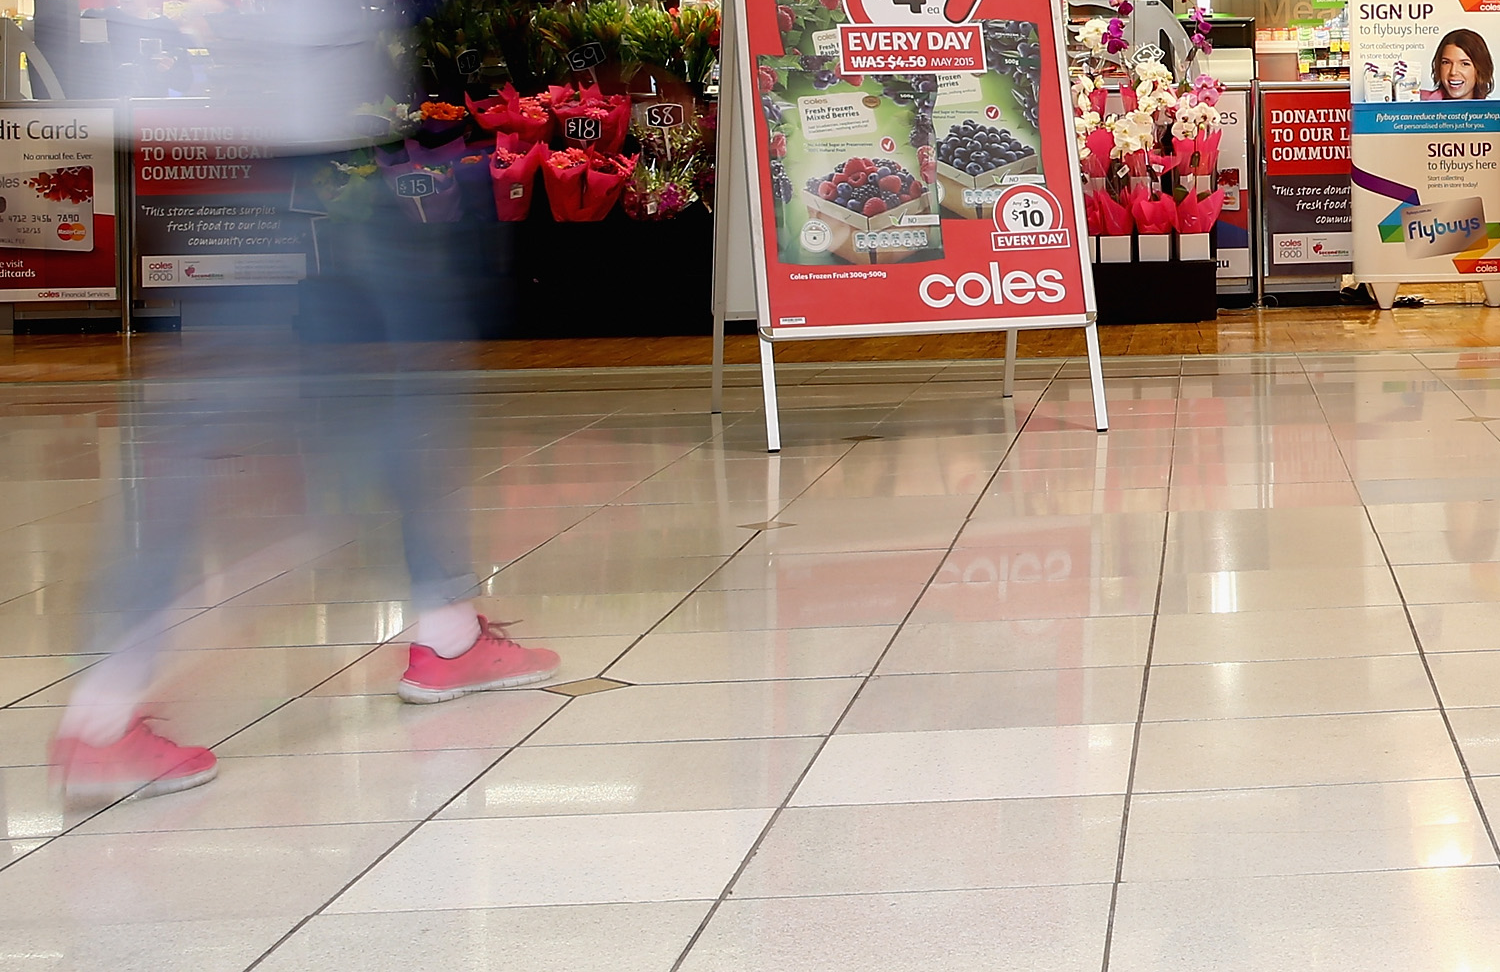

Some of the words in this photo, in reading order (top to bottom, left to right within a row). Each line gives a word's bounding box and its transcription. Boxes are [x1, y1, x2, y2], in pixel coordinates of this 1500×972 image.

[927, 5, 940, 14] ea
[1360, 3, 1402, 20] SIGN
[1408, 3, 1434, 20] UP
[1360, 25, 1371, 35] to
[1373, 23, 1412, 37] flybuys
[1415, 23, 1440, 35] here
[848, 31, 921, 52] EVERY
[928, 31, 973, 50] DAY
[1359, 42, 1374, 50] Start
[1375, 42, 1404, 51] collecting
[1405, 42, 1425, 51] points
[851, 56, 886, 68] WAS
[888, 55, 927, 69] $4.50
[930, 56, 952, 67] MAY
[954, 56, 975, 66] 2015
[1004, 58, 1020, 66] 500g
[1383, 52, 1403, 61] today!
[803, 96, 828, 106] coles
[651, 107, 674, 125] $8
[805, 107, 826, 116] Fresh
[828, 104, 854, 114] Frozen
[806, 113, 831, 122] Mixed
[832, 110, 860, 119] Berries
[1376, 112, 1400, 122] flybuys
[1400, 113, 1412, 121] can
[1413, 113, 1435, 121] reduce
[1468, 114, 1484, 122] your
[1484, 113, 1500, 121] shop.
[26, 119, 89, 140] Cards
[568, 117, 596, 139] $18
[141, 127, 234, 142] DONATING
[1271, 129, 1294, 143] TO
[1300, 127, 1334, 142] OUR
[141, 147, 165, 162] TO
[171, 146, 208, 161] OUR
[215, 145, 275, 160] LOCAL
[1427, 142, 1465, 158] SIGN
[1470, 142, 1492, 157] UP
[23, 153, 34, 161] No
[36, 152, 64, 161] annual
[65, 152, 75, 161] fee.
[76, 153, 93, 161] Ever.
[1428, 162, 1437, 170] to
[1440, 160, 1474, 172] flybuys
[1476, 159, 1497, 169] here
[141, 164, 252, 181] COMMUNITY
[1441, 175, 1465, 183] collecting
[1296, 186, 1321, 196] store
[1023, 198, 1031, 208] 3
[1296, 199, 1321, 212] fresh
[1323, 199, 1347, 212] food
[167, 206, 194, 217] store
[197, 205, 237, 216] donates
[239, 205, 276, 219] surplus
[1011, 208, 1045, 228] $10
[8, 215, 27, 224] 4712
[57, 213, 80, 223] 7890
[167, 220, 195, 233] fresh
[197, 220, 222, 233] food
[223, 221, 236, 230] to
[238, 222, 256, 231] our
[257, 219, 281, 230] local
[1408, 216, 1481, 244] flybuys
[188, 233, 243, 248] community
[246, 234, 273, 247] every
[997, 235, 1036, 247] EVERY
[1039, 233, 1064, 245] DAY
[1279, 238, 1303, 248] coles
[1279, 248, 1303, 259] FOOD
[6, 259, 23, 268] visit
[148, 261, 173, 271] coles
[1475, 265, 1498, 273] coles
[148, 272, 174, 282] FOOD
[809, 272, 832, 280] Frozen
[850, 271, 887, 280] 300g-500g
[918, 261, 1067, 309] coles
[38, 290, 60, 298] coles
[61, 290, 85, 298] Financial
[86, 290, 110, 298] Services
